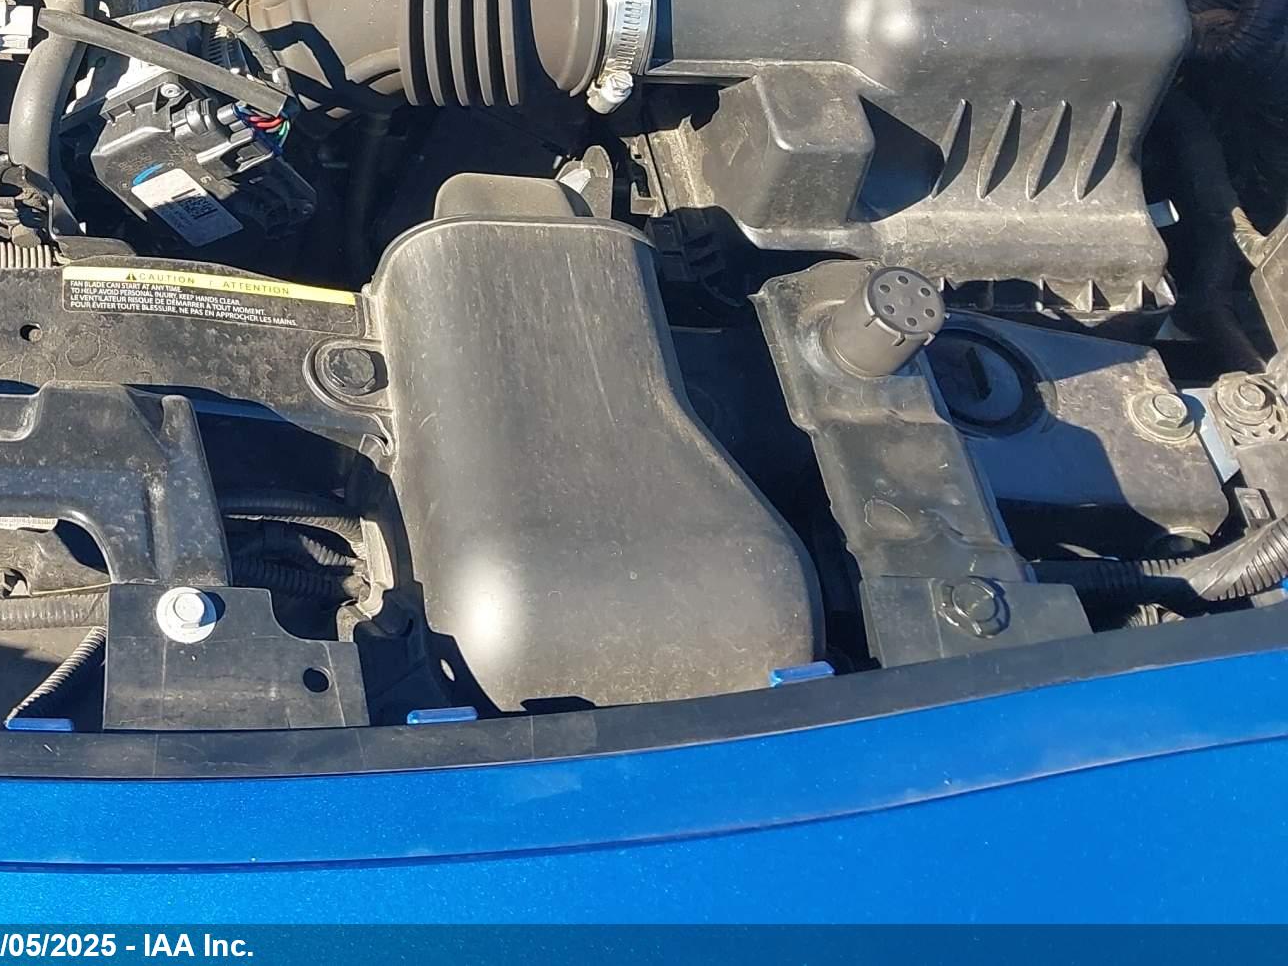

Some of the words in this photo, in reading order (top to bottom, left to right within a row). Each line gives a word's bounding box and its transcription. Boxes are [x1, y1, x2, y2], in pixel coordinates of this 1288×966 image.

[139, 273, 195, 284] CAUTION
[223, 281, 289, 294] ATTENTION
[80, 294, 127, 303] VENTILATEUR
[128, 296, 153, 305] RISQUE
[212, 304, 231, 312] TOUT
[120, 289, 153, 297] PERSONAL
[196, 295, 218, 303] HANDS
[117, 302, 140, 310] TOUTE
[179, 306, 189, 314] NE
[190, 307, 203, 315] PAS
[205, 309, 214, 317] EN
[215, 310, 258, 322] APPROCHER
[259, 315, 272, 323] LES
